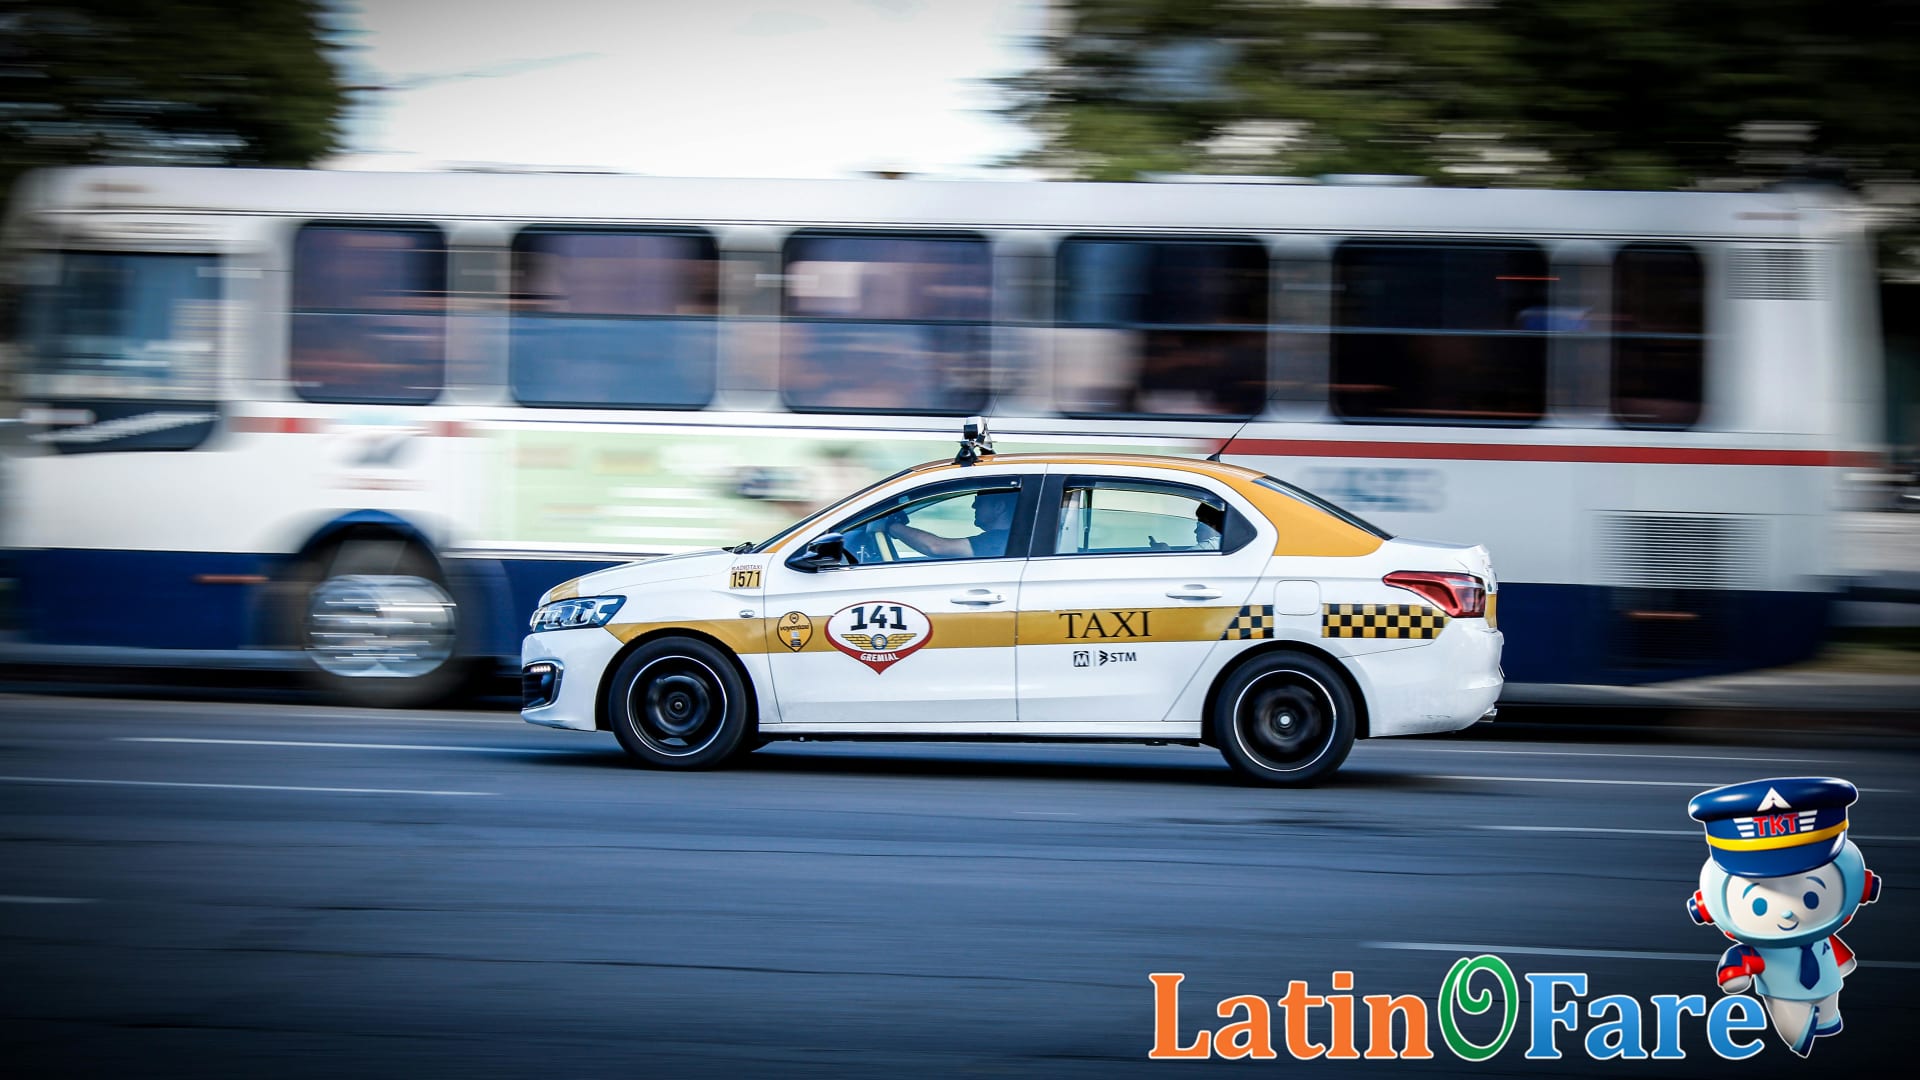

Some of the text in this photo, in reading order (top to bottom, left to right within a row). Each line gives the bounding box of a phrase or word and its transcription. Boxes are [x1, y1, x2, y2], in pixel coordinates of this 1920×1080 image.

[731, 570, 761, 588] 1571
[850, 605, 907, 631] 141
[1058, 610, 1153, 639] TAXI
[860, 652, 900, 662] GREMIAL
[1110, 651, 1137, 663] STM
